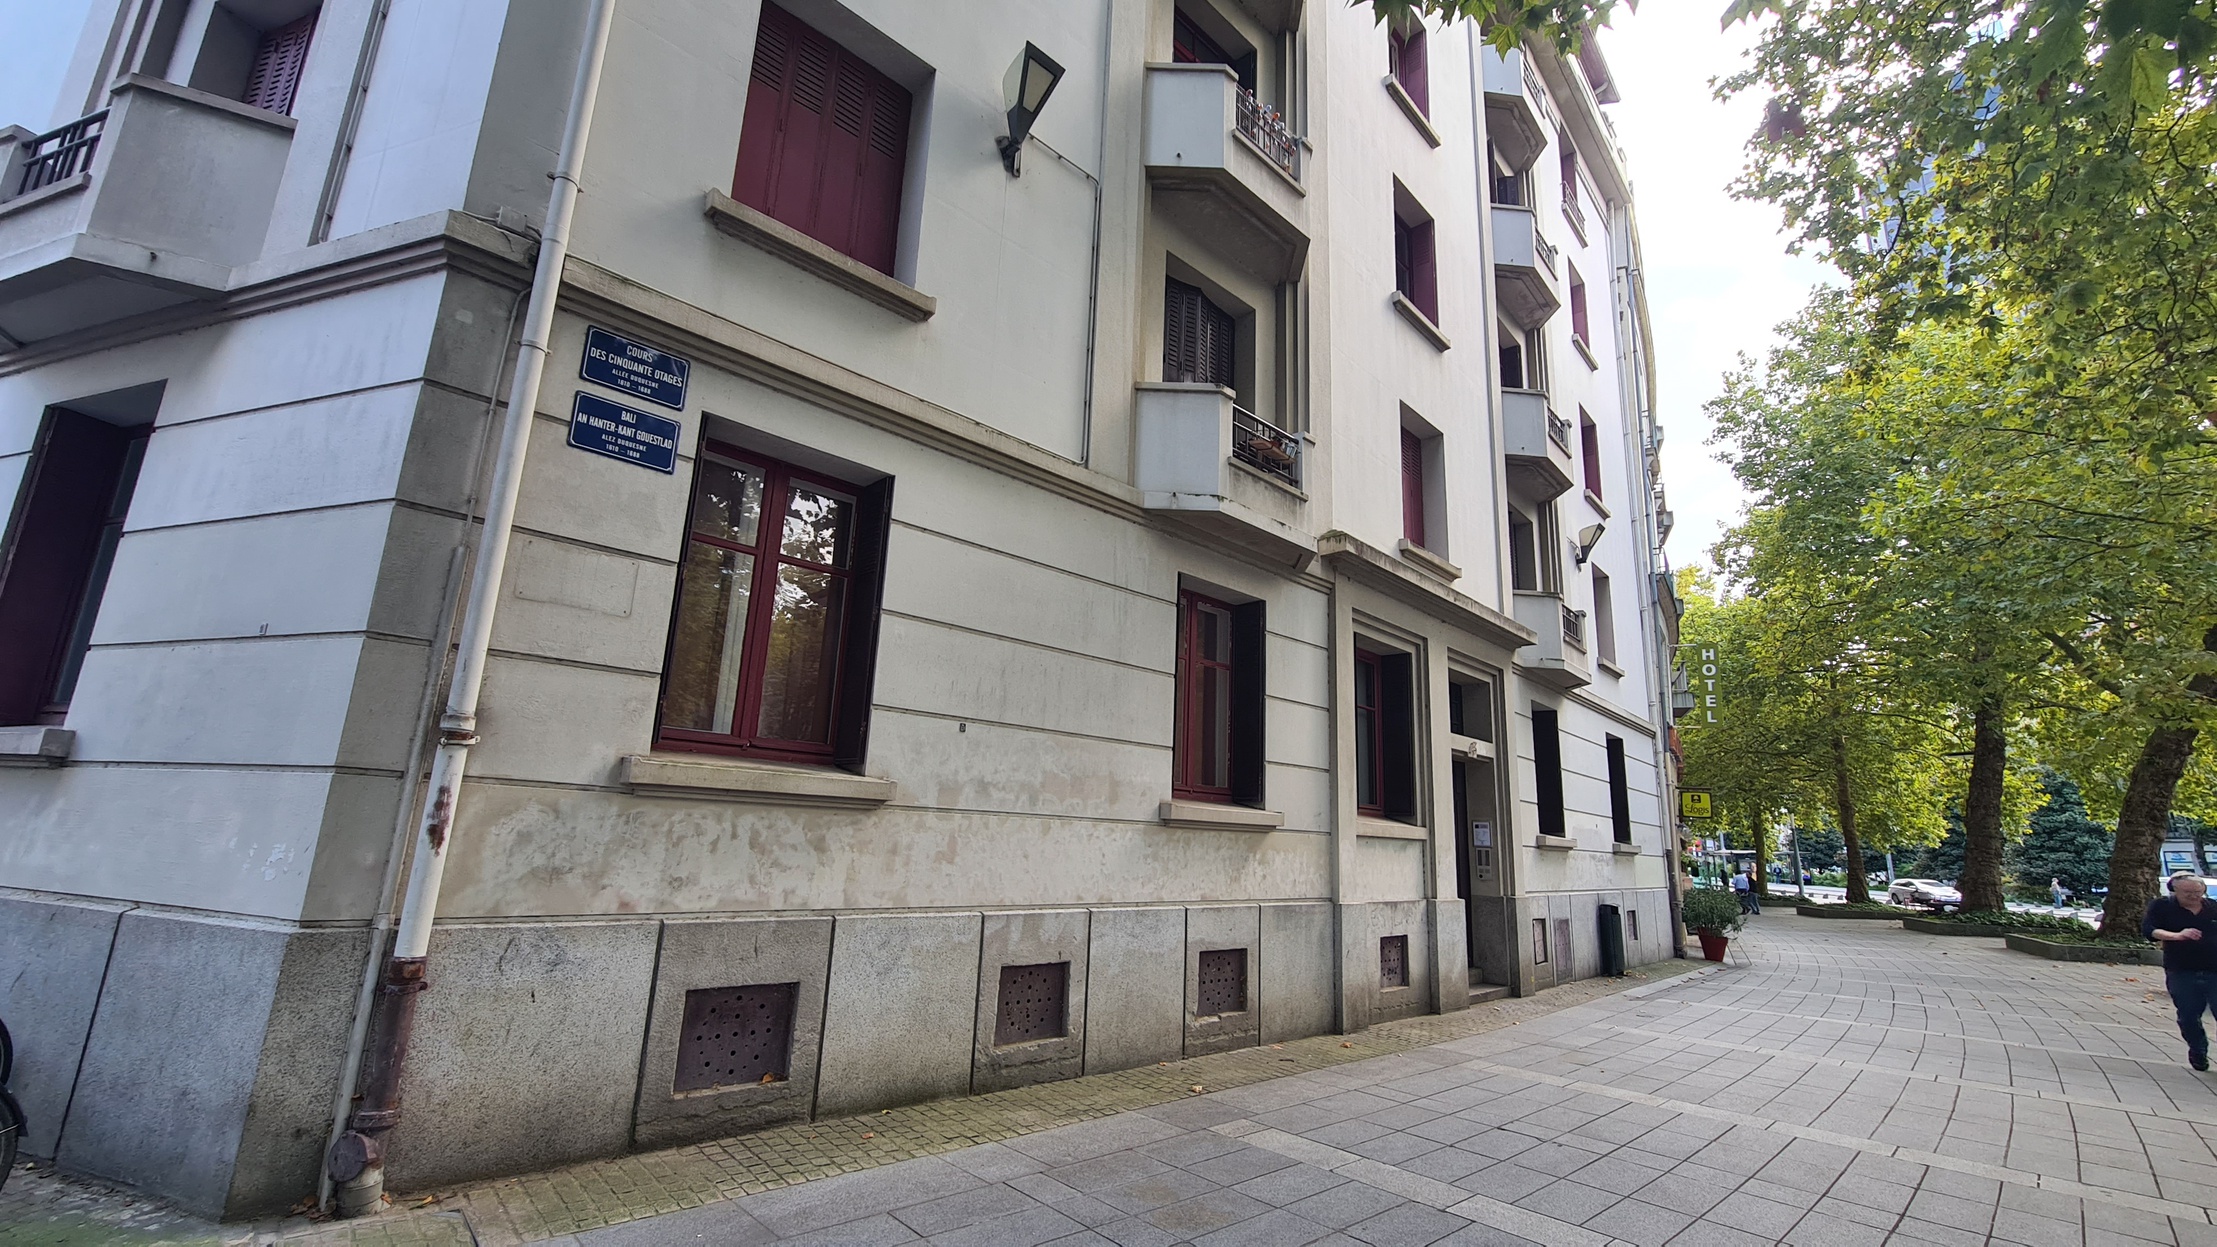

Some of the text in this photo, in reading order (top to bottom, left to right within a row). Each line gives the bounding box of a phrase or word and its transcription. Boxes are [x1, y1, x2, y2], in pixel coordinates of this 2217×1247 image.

[626, 345, 653, 362] COURS
[590, 347, 683, 388] DES CINQUANTE OTAGES
[630, 374, 659, 389] DUQUESNE
[621, 411, 637, 424] BALI
[577, 412, 673, 450] AN HANTER-KANT GOUESTLAD
[601, 433, 647, 452] ALEZ DUQUESNE
[605, 443, 619, 452] 1610
[1701, 648, 1717, 723] HOTEL
[1685, 803, 1709, 815] Logis
